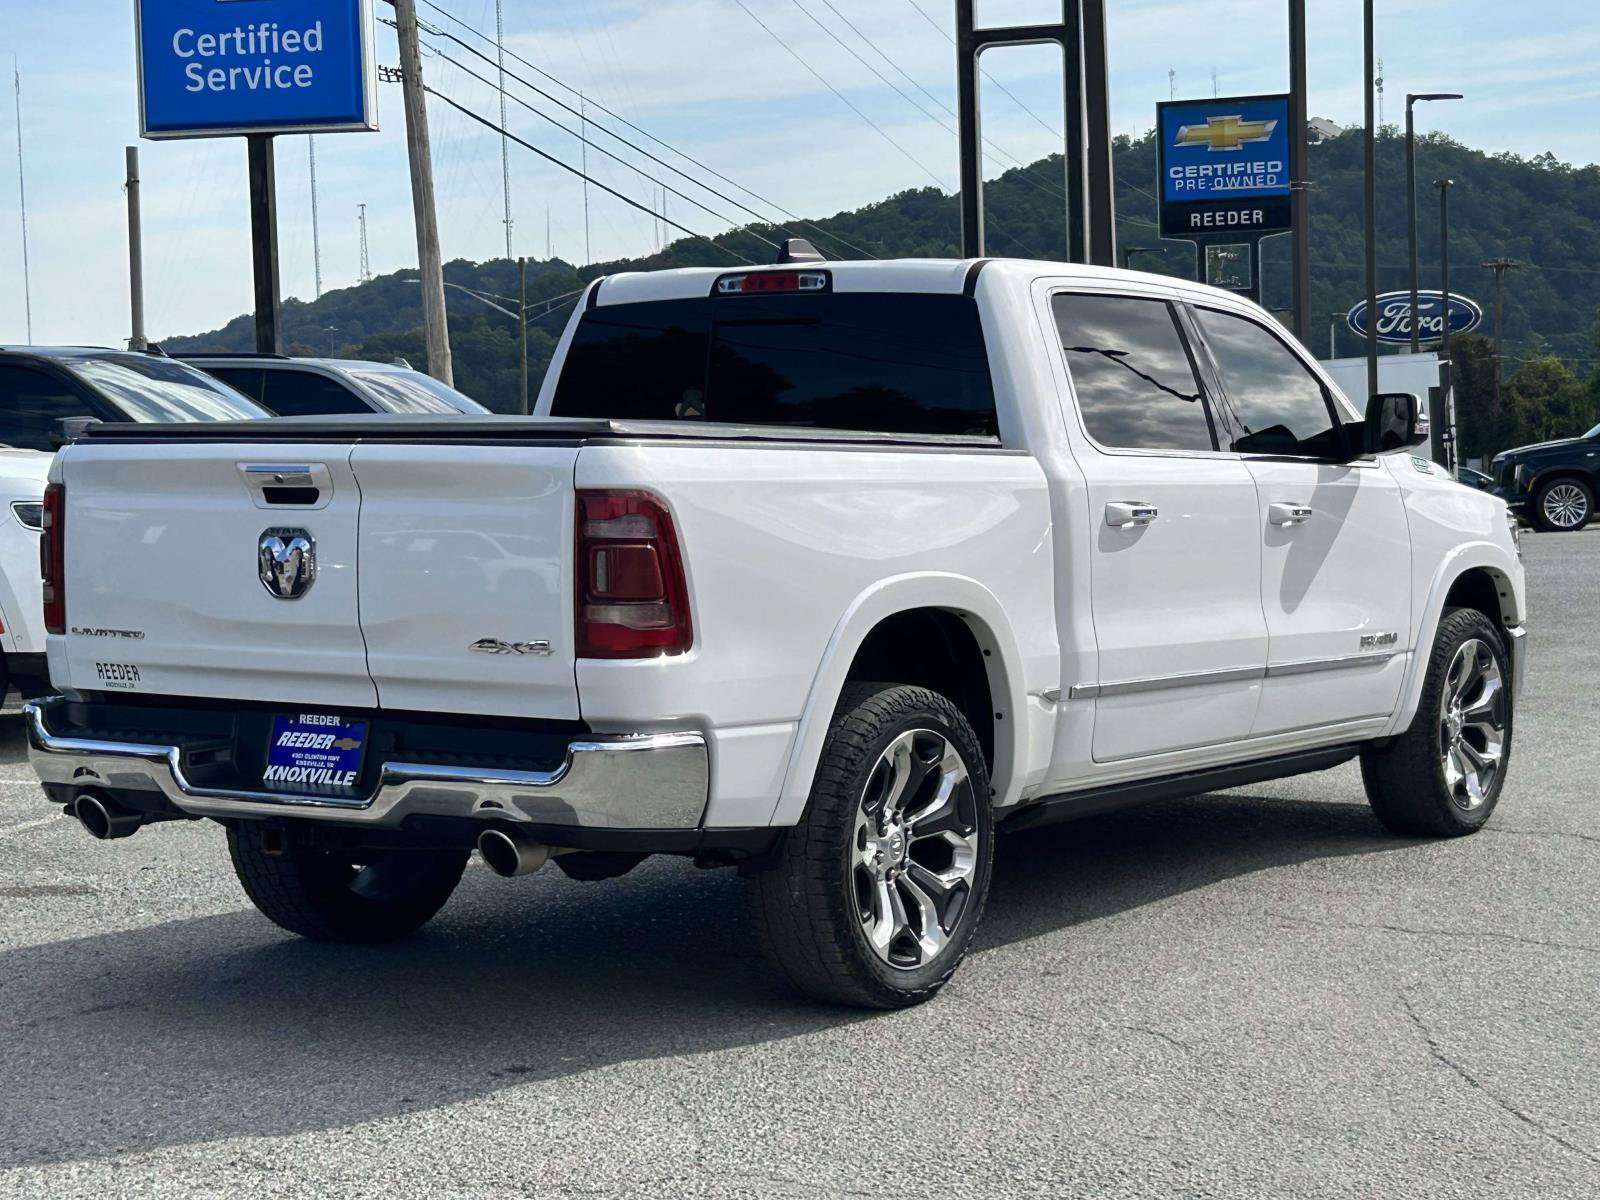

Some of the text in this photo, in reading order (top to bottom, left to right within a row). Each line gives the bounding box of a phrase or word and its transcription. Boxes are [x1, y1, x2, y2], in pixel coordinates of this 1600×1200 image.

[172, 20, 323, 58] Certified
[185, 58, 313, 93] Service
[1169, 160, 1282, 179] CERTIFIED
[1175, 174, 1277, 191] PRE-OWNED
[1190, 209, 1263, 227] REEDER
[1376, 302, 1454, 333] Ford
[95, 662, 141, 681] REEDER
[299, 714, 341, 727] REEDER
[276, 731, 336, 750] REEDER
[262, 764, 357, 786] KNOXVILLE
